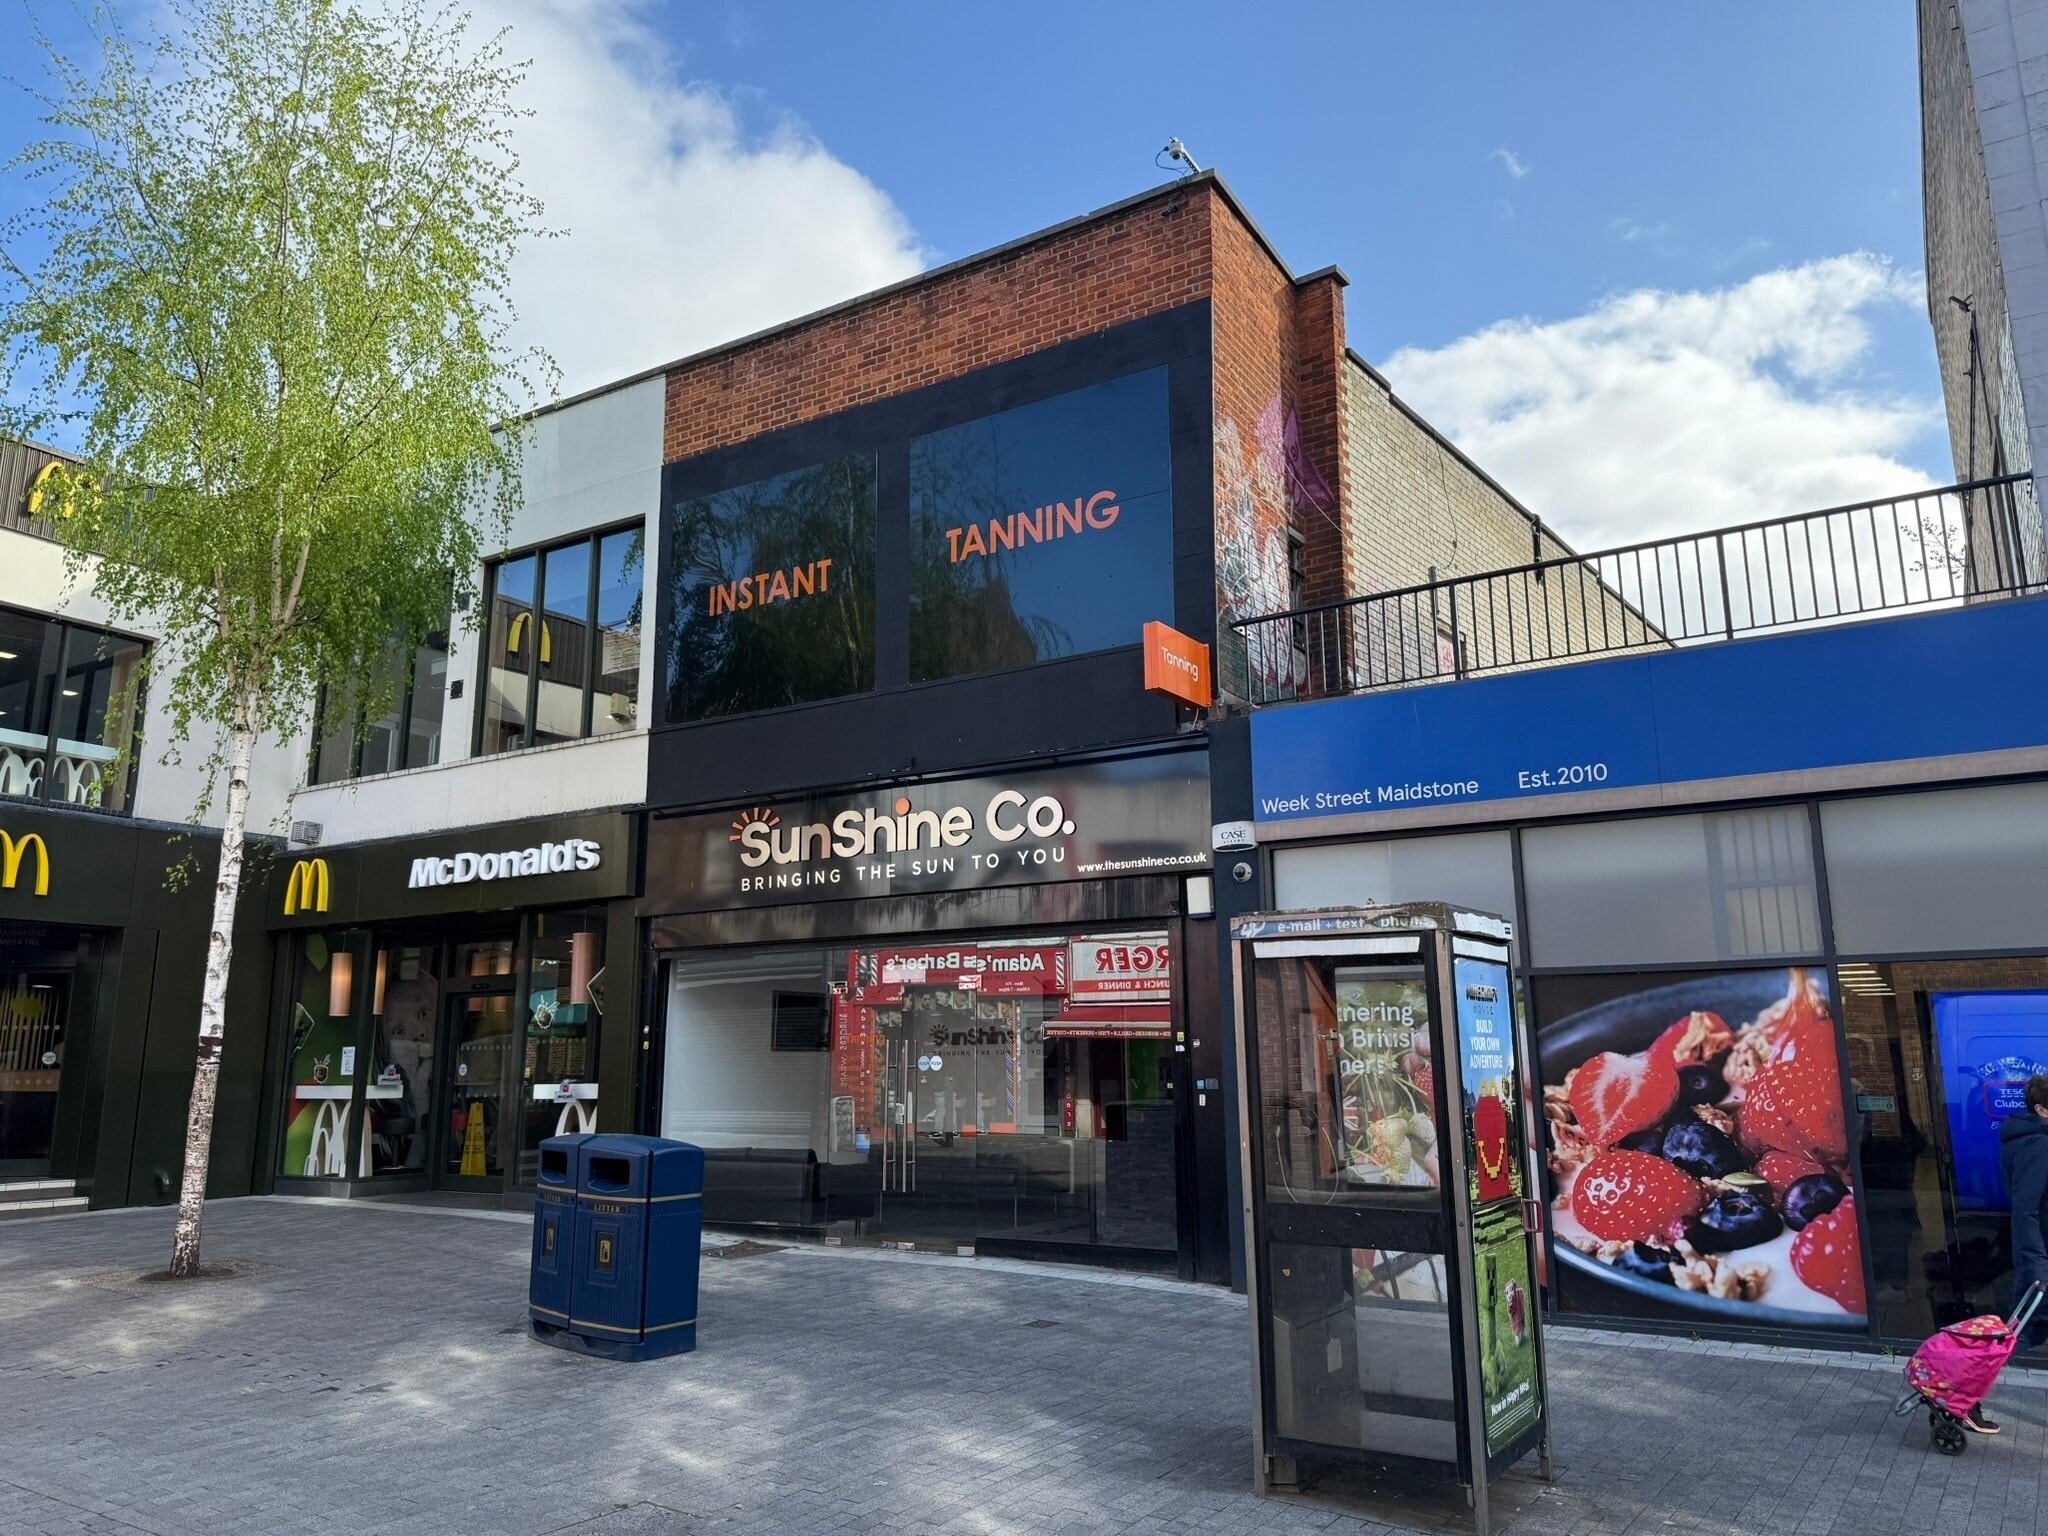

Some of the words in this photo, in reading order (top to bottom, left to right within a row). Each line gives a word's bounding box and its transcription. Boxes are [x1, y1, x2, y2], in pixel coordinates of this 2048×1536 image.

[946, 489, 1121, 564] TANNING
[708, 558, 833, 619] INSTANT
[1161, 646, 1199, 682] Tanning
[1518, 762, 1609, 789] Est.2010
[1261, 793, 1311, 815] Week
[1315, 787, 1372, 809] Street
[1377, 779, 1480, 804] Maidstone
[985, 790, 1077, 842] Co.
[1221, 830, 1247, 840] CASE
[408, 838, 601, 889] McDonald's
[741, 868, 842, 892] BRINGING
[856, 863, 897, 882] THE
[911, 857, 956, 877] SUN
[972, 852, 1000, 871] TO
[1017, 846, 1067, 866] YOU
[1076, 850, 1208, 873] www.thesunshineco.co.uk
[1277, 918, 1321, 933] e-mail
[1336, 917, 1365, 929] text
[1475, 1019, 1493, 1034] BUILD
[1469, 1036, 1486, 1051] YOUR
[1486, 1037, 1501, 1052] OWN
[1469, 1054, 1504, 1069] ADVENTURE
[594, 1203, 621, 1213] LITTER
